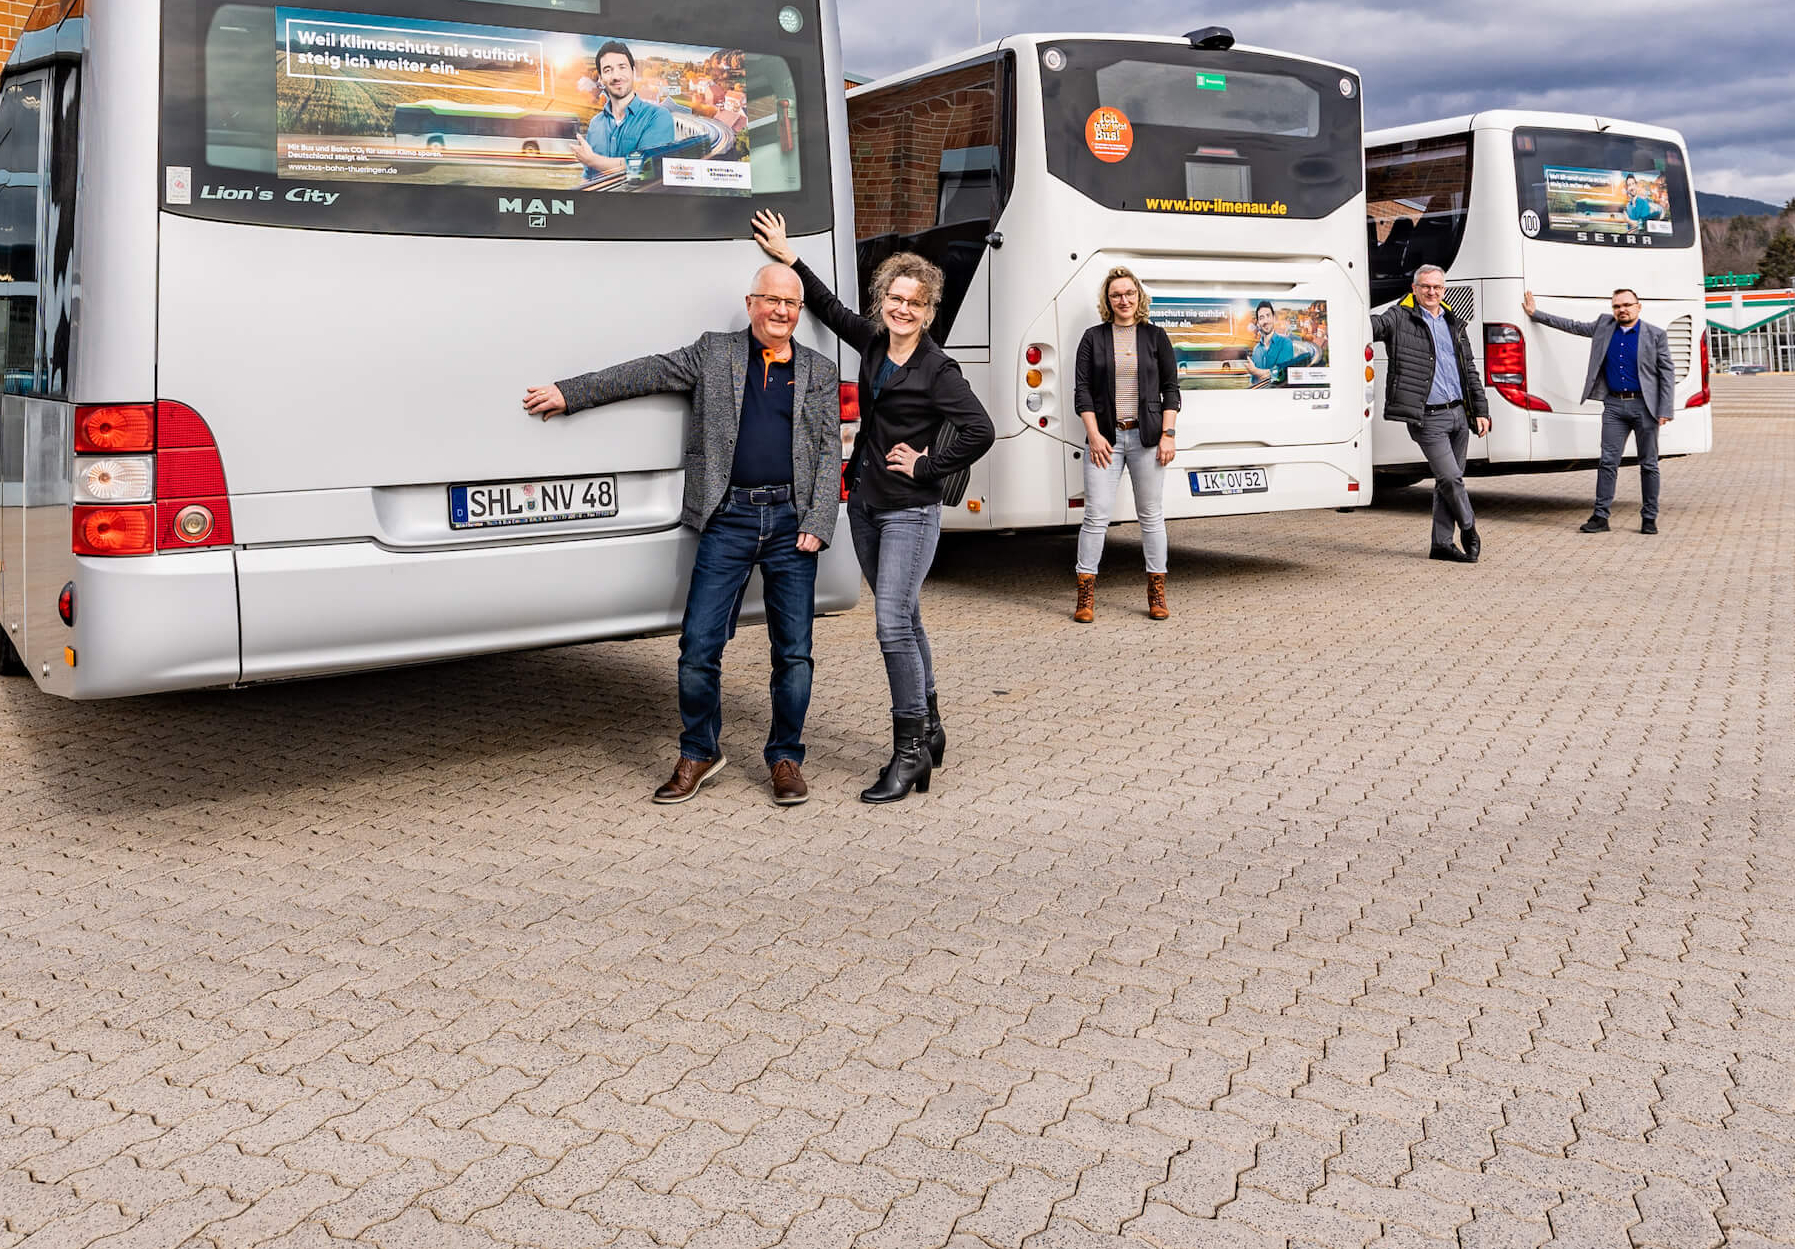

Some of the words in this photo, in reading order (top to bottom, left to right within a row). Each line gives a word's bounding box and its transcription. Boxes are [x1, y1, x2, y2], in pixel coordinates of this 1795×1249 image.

[297, 30, 335, 47] Weil
[339, 34, 441, 56] Klimaschutz
[444, 43, 468, 58] nie
[472, 46, 534, 65] aufhört,
[297, 52, 341, 70] steig
[345, 53, 370, 68] ich
[374, 57, 427, 73] weiter
[431, 61, 460, 75] ein.
[287, 143, 300, 151] Mit
[287, 151, 334, 160] Deutschland
[334, 154, 356, 162] steigt
[200, 185, 274, 201] Lion's
[285, 187, 340, 205] City
[498, 197, 575, 215] MAN
[1145, 197, 1288, 215] www.iov-ilmenau.de
[1523, 214, 1538, 232] 100
[1576, 232, 1652, 245] SETRA
[1185, 309, 1198, 317] nie
[1203, 473, 1220, 489] IK
[1227, 472, 1242, 488] OV
[1244, 472, 1261, 486] 52
[470, 488, 522, 518] SHL
[541, 484, 574, 512] NV
[582, 481, 613, 508] 48
